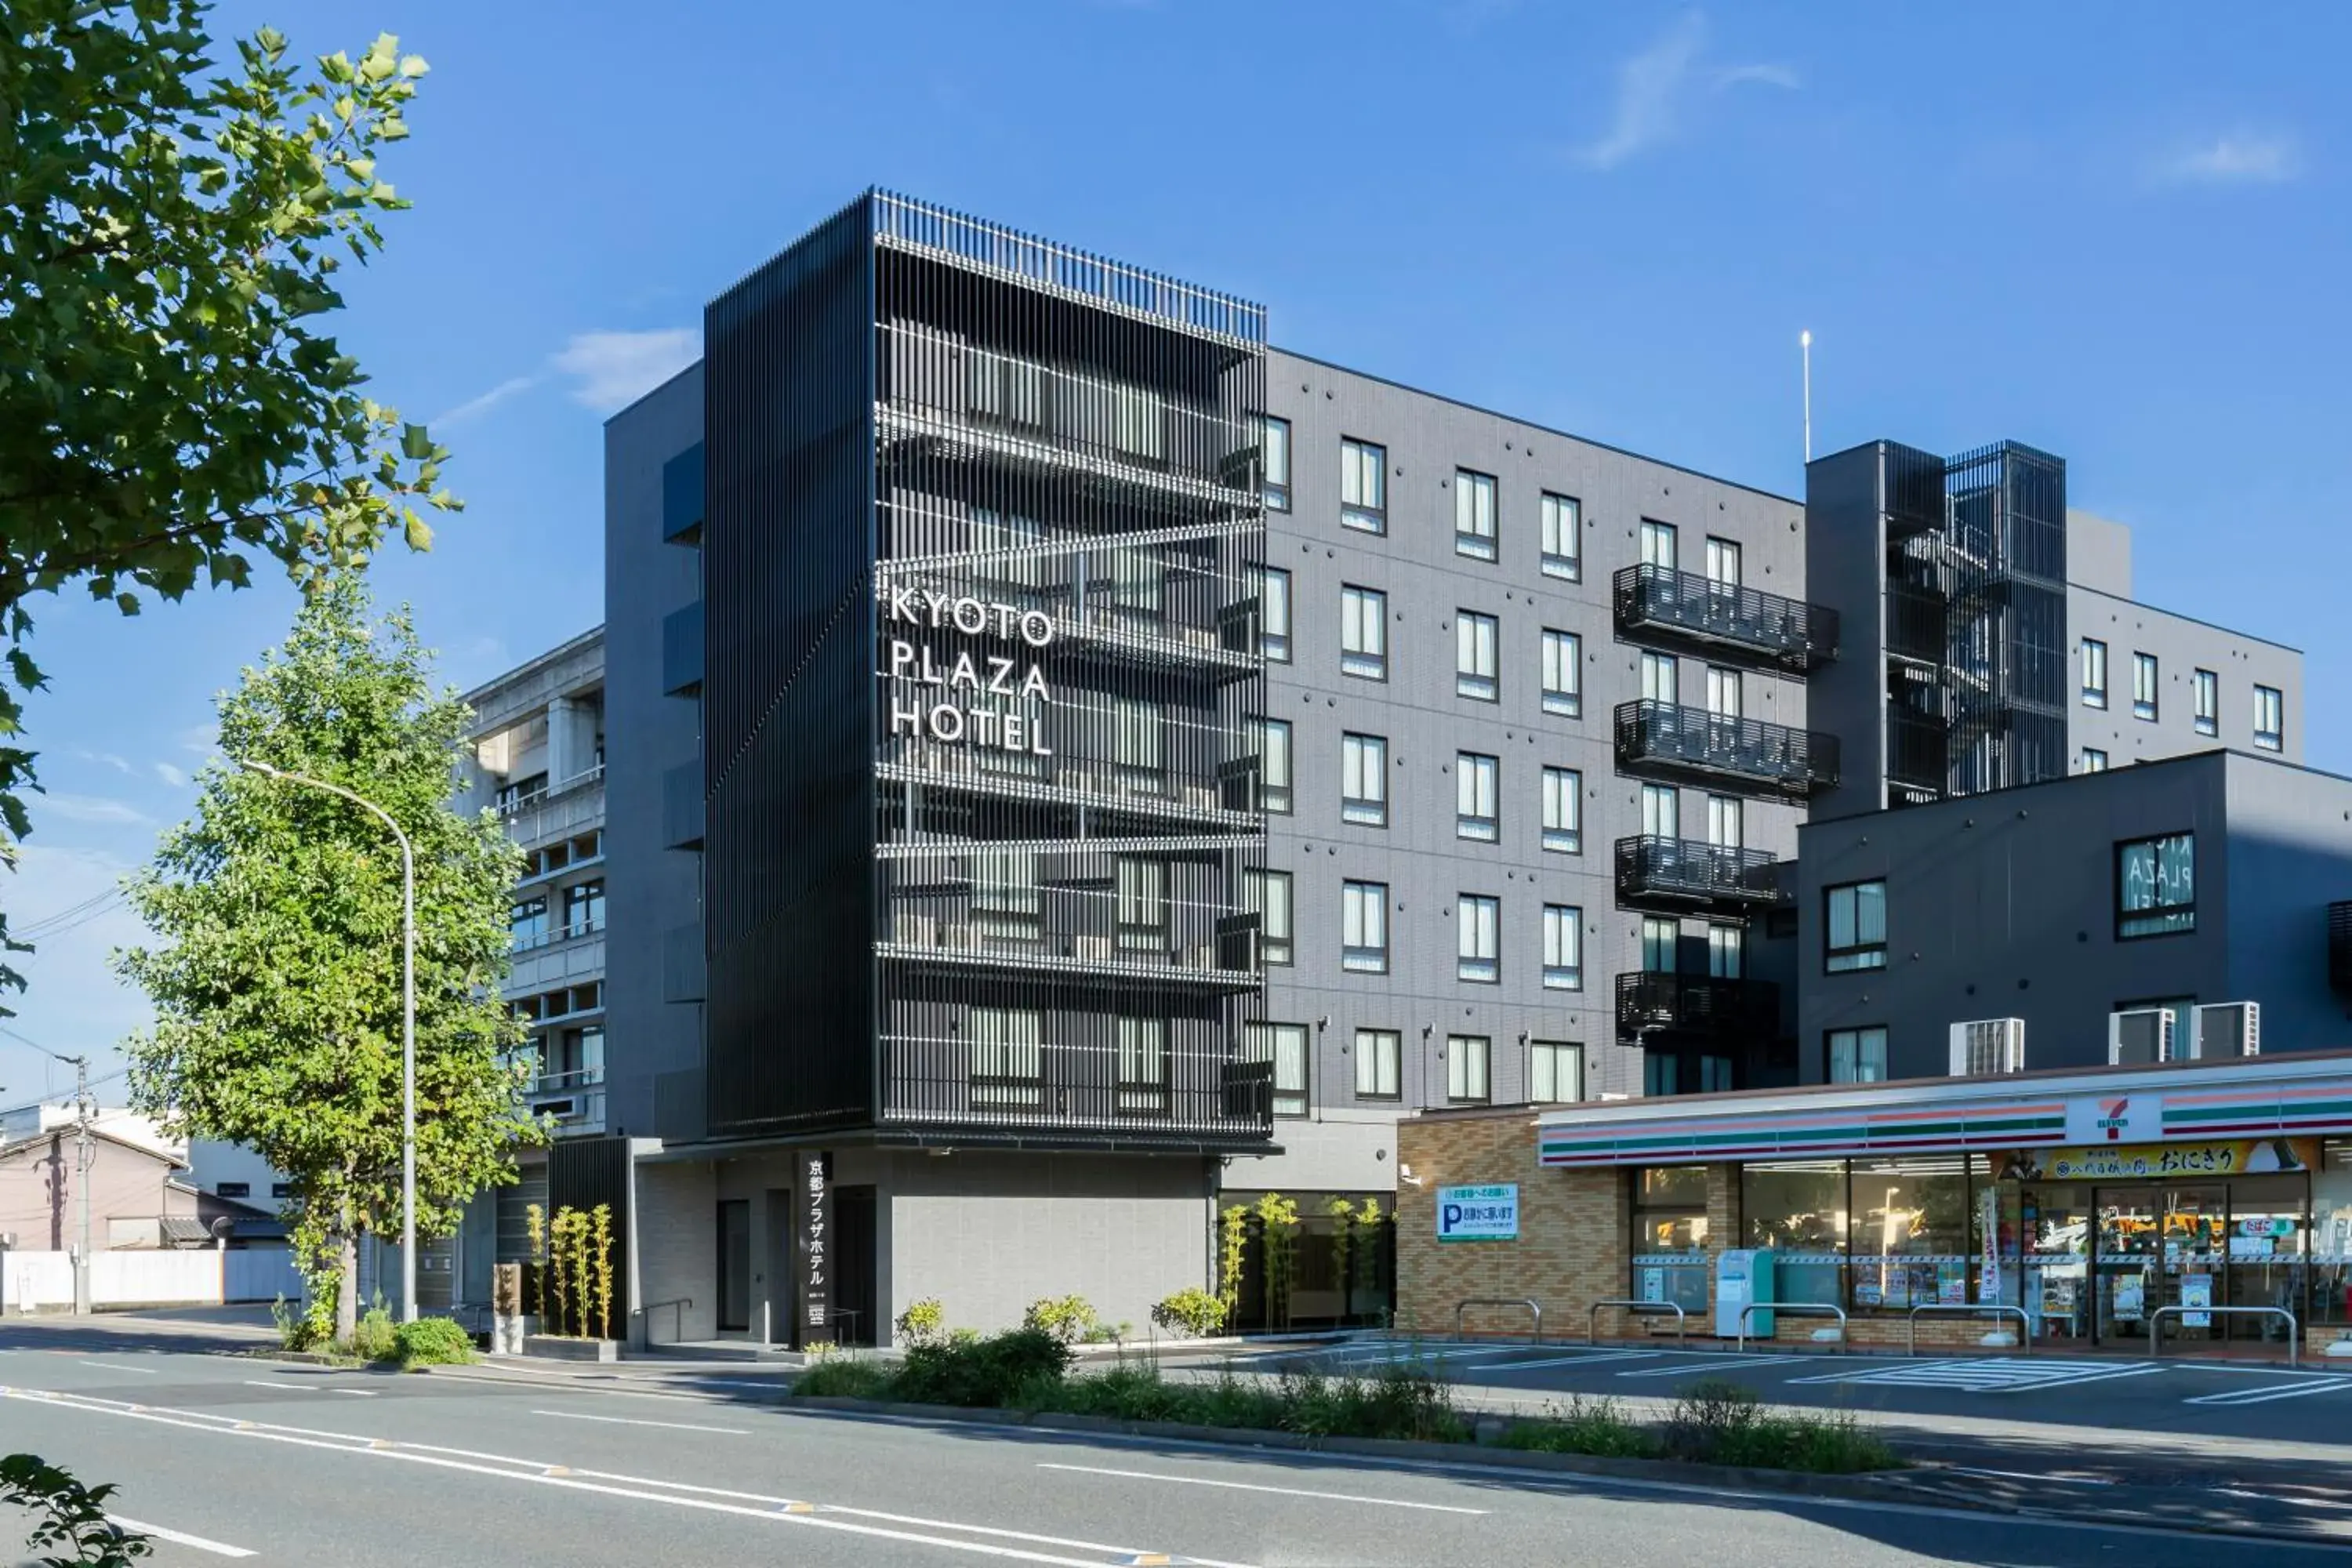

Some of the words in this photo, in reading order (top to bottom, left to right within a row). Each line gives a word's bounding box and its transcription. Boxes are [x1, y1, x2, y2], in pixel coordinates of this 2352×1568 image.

[891, 584, 1053, 647] KYOTO
[891, 640, 1050, 702] PLAZA
[891, 696, 1052, 755] HOTEL
[2098, 1098, 2129, 1140] 7
[809, 1160, 824, 1285] 京都プラザホテル
[1443, 1204, 1461, 1232] P
